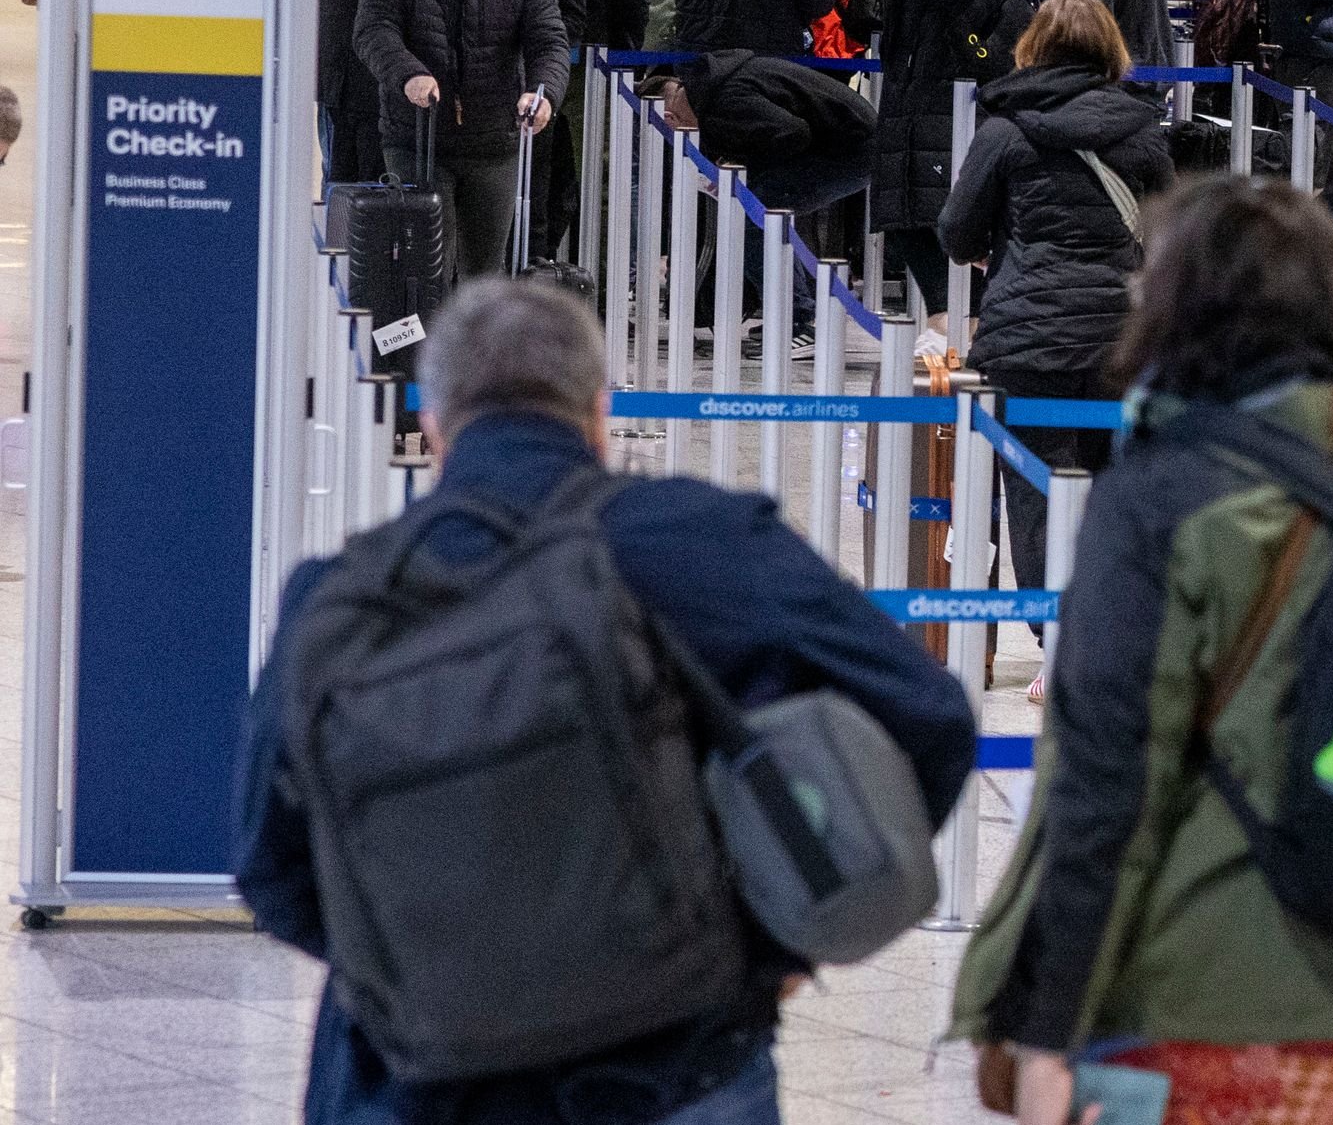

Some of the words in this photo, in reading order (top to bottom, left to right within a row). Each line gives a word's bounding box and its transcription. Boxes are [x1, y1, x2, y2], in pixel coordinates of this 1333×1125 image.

[107, 95, 217, 127] Priority
[107, 129, 243, 159] Check-in
[106, 174, 166, 191] Business
[168, 175, 206, 191] Class
[105, 193, 164, 210] Premium
[168, 195, 232, 213] Economy
[699, 397, 860, 418] discover.airlines
[908, 595, 1058, 617] discover.airl
